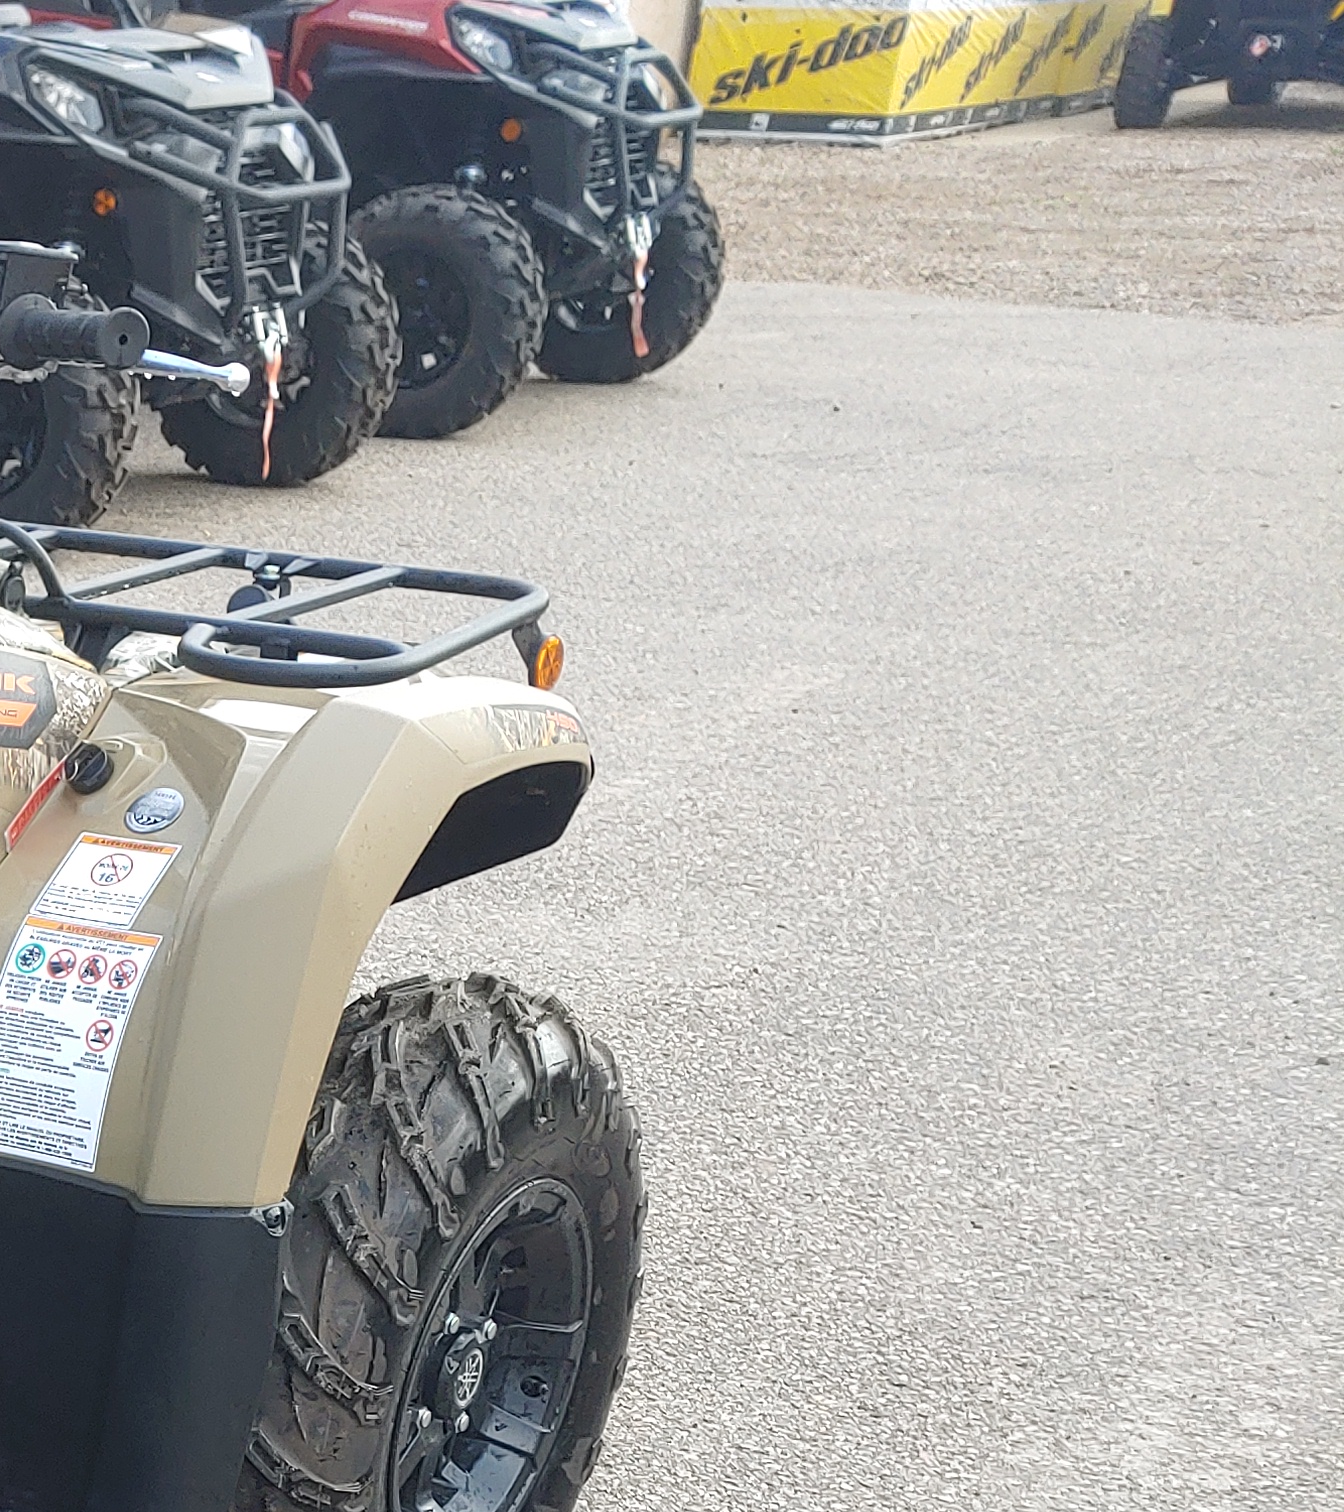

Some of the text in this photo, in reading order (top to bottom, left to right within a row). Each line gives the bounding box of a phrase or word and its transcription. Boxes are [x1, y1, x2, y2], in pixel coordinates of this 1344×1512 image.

[709, 15, 909, 105] ski-doo
[545, 709, 580, 735] 450
[98, 871, 116, 884] 16
[63, 924, 130, 942] AVERTISSEMENT
